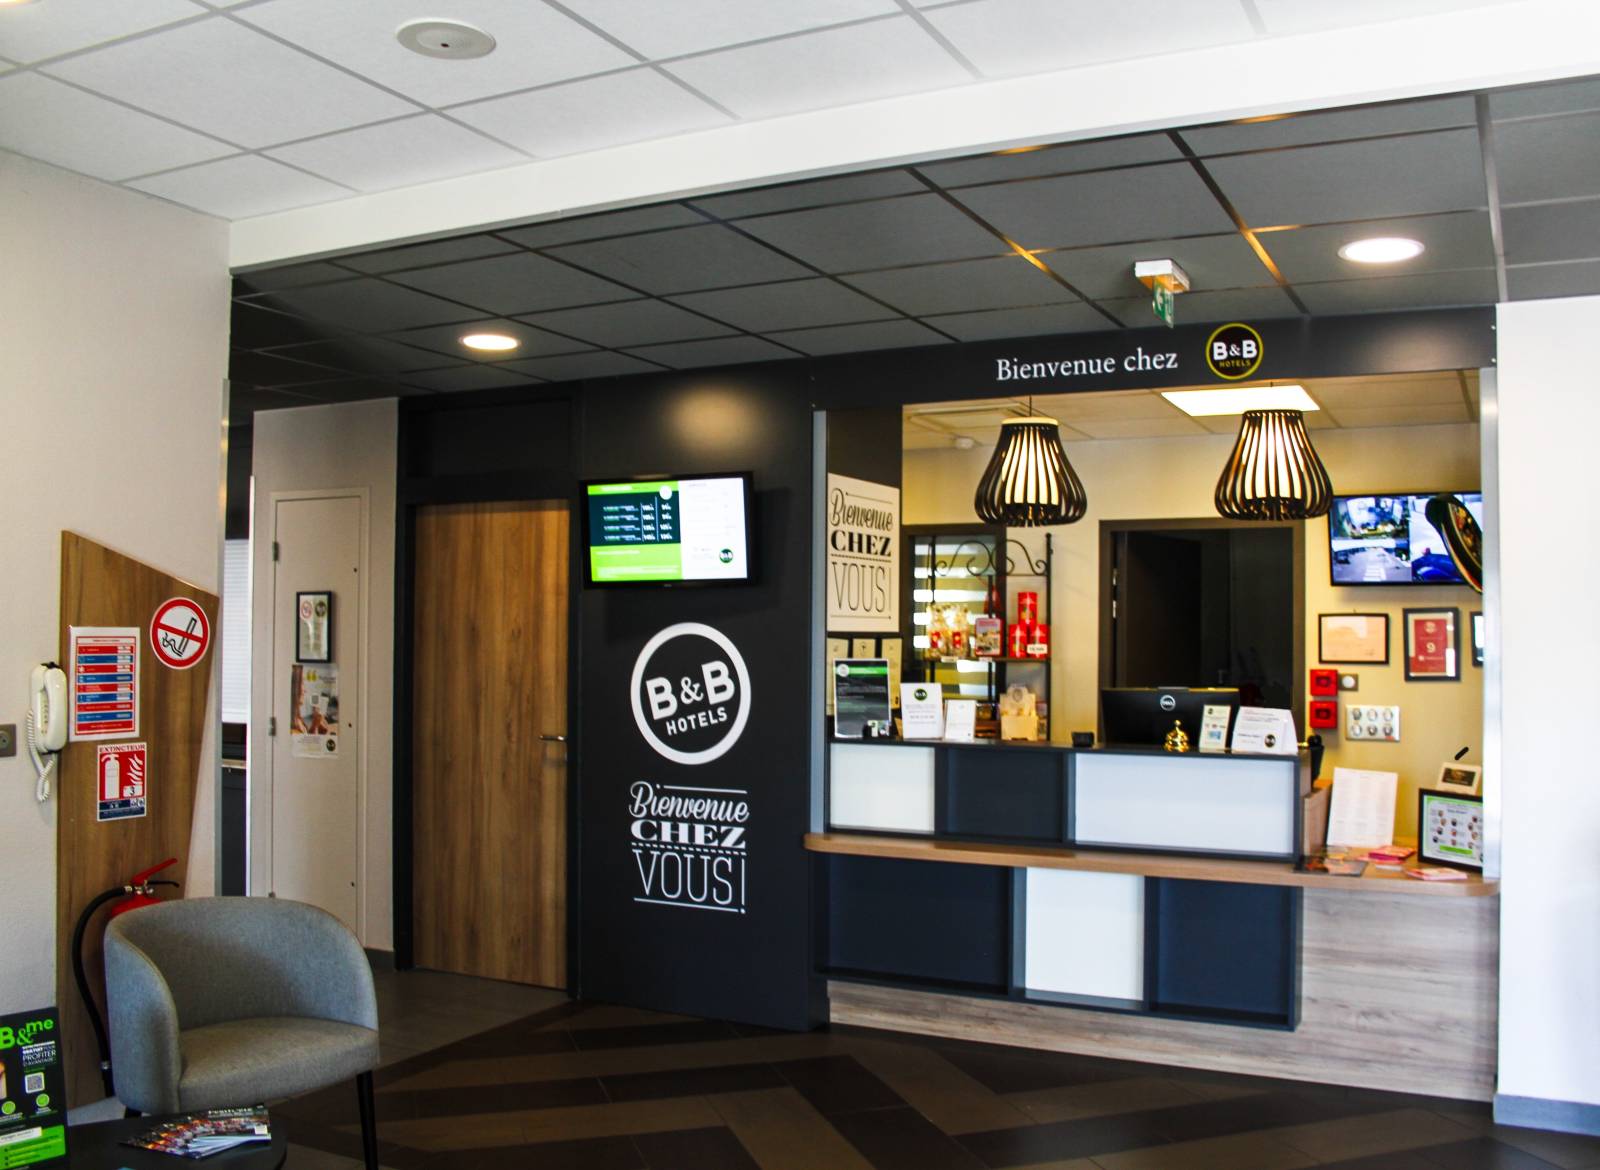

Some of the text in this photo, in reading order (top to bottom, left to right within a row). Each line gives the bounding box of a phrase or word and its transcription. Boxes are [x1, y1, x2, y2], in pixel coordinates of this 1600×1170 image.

[996, 346, 1178, 381] Bienvenue chez
[1213, 339, 1258, 361] B&B
[1219, 359, 1251, 368] HOTELS
[829, 487, 894, 532] Bienvenue
[830, 529, 892, 558] CHEZ
[645, 660, 736, 720] B&B
[665, 706, 728, 736] HOTELS
[629, 780, 750, 823] Bienvenue
[630, 819, 747, 849] CHEZ
[632, 848, 746, 914] VOUS!
